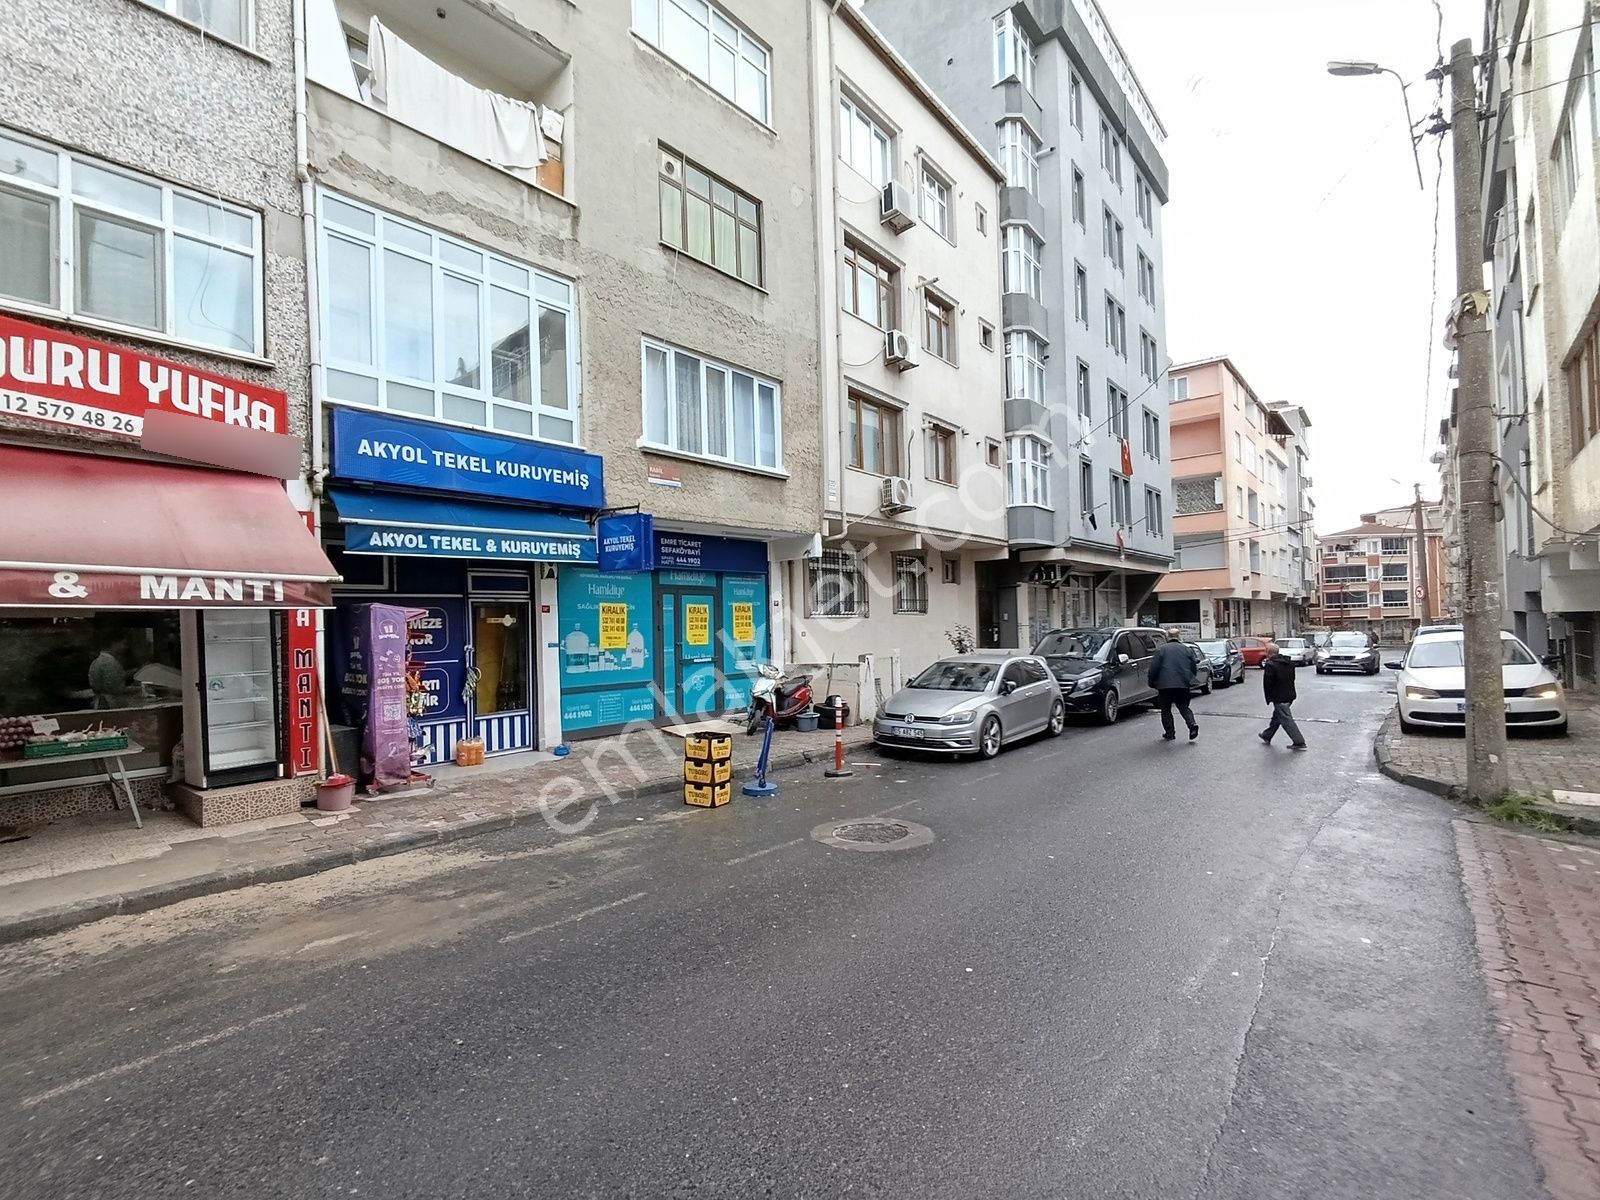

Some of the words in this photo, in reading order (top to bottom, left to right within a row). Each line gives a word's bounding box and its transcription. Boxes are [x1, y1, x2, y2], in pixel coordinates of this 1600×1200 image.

[0, 335, 121, 396] URU
[139, 359, 276, 433] YUFKA
[36, 401, 74, 421] 579
[81, 409, 106, 428] 48
[112, 415, 135, 433] 26
[357, 438, 428, 466] AKYOL
[432, 450, 492, 475] TEKEL
[496, 460, 590, 491] KURUYEMİŞ
[369, 531, 428, 549] AKYOL
[430, 535, 482, 552] TEKEL
[486, 539, 498, 552] &
[501, 540, 581, 559] KURUYEMİŞ
[603, 537, 620, 546] AKYOL
[620, 535, 636, 544] TEKEL
[661, 537, 677, 546] EMRE
[678, 538, 702, 548] TİCARET
[605, 542, 635, 553] KURUYEMİŞ
[48, 571, 89, 599] &
[140, 574, 285, 603] MANTI
[410, 617, 442, 629] MEZE
[294, 648, 314, 769] MANTI
[577, 709, 592, 719] 1902
[688, 744, 706, 752] TUBORG
[688, 767, 709, 776] TUBORG
[688, 791, 709, 799] TUBORG
